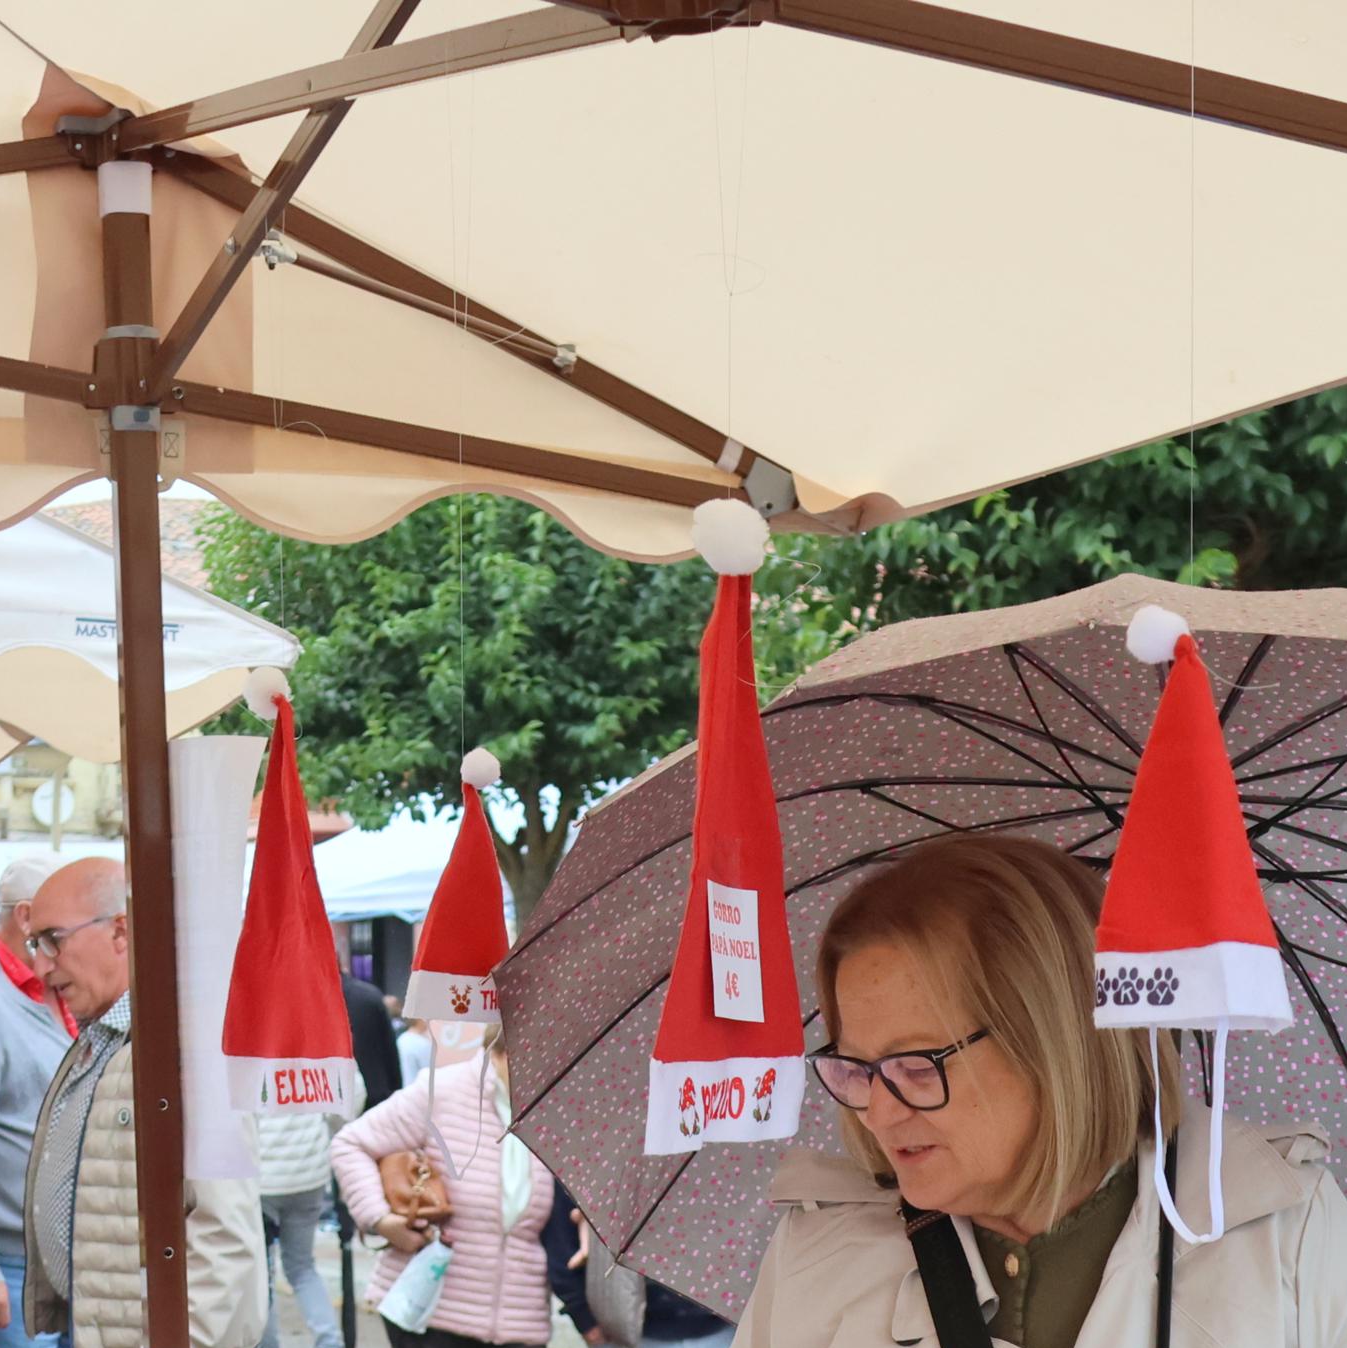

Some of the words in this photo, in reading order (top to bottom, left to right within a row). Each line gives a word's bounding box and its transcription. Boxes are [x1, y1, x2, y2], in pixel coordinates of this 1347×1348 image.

[713, 900, 741, 925] GORRO
[711, 931, 729, 958] PAPÁ
[729, 938, 758, 961] NOEL
[725, 969, 741, 1000] 4€
[274, 1068, 335, 1106] ELENA
